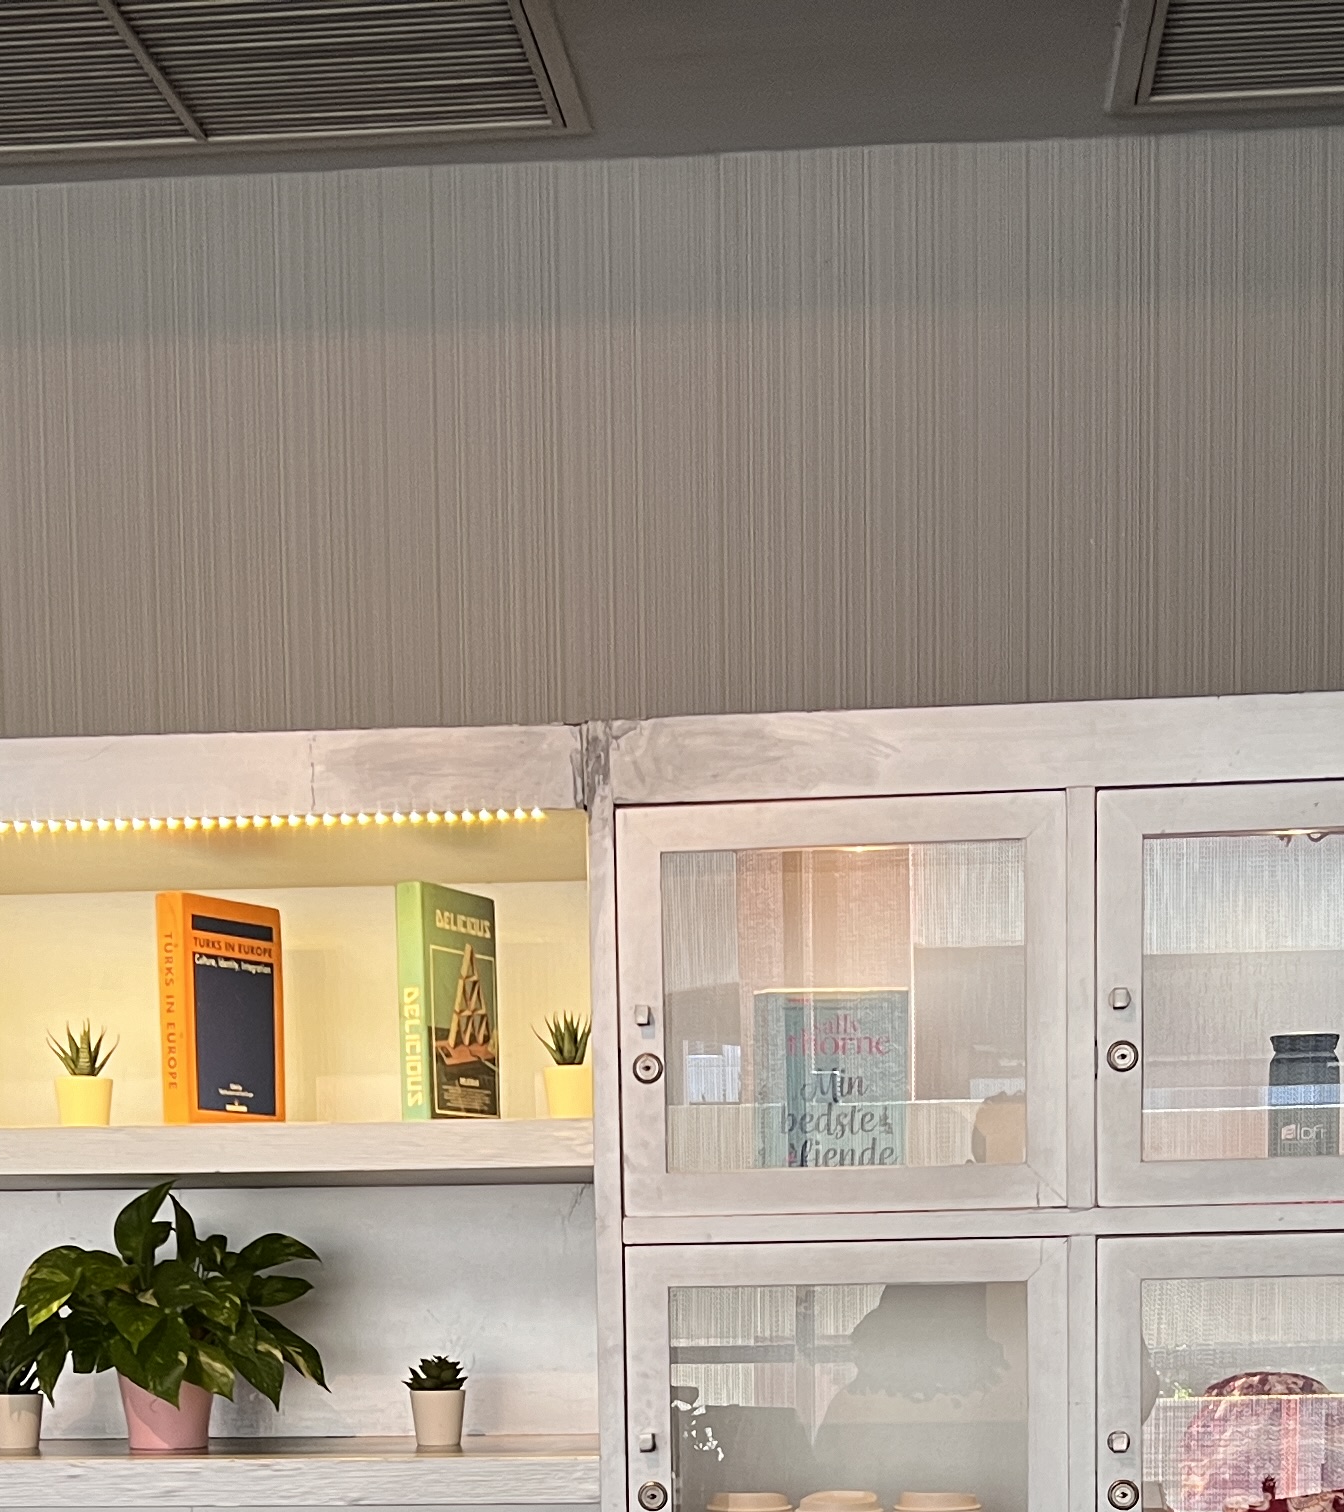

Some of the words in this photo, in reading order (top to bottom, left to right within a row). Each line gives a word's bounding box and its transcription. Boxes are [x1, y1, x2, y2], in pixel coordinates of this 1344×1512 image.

[434, 908, 492, 939] DELICIOUS
[162, 931, 176, 988] TURKS
[193, 936, 222, 951] TURKS
[224, 941, 236, 953] IN
[237, 943, 273, 959] EUROPE
[165, 994, 176, 1014] IN
[166, 1022, 178, 1090] EUROPE
[403, 986, 424, 1108] DELICIOUS
[800, 1067, 870, 1104] Min
